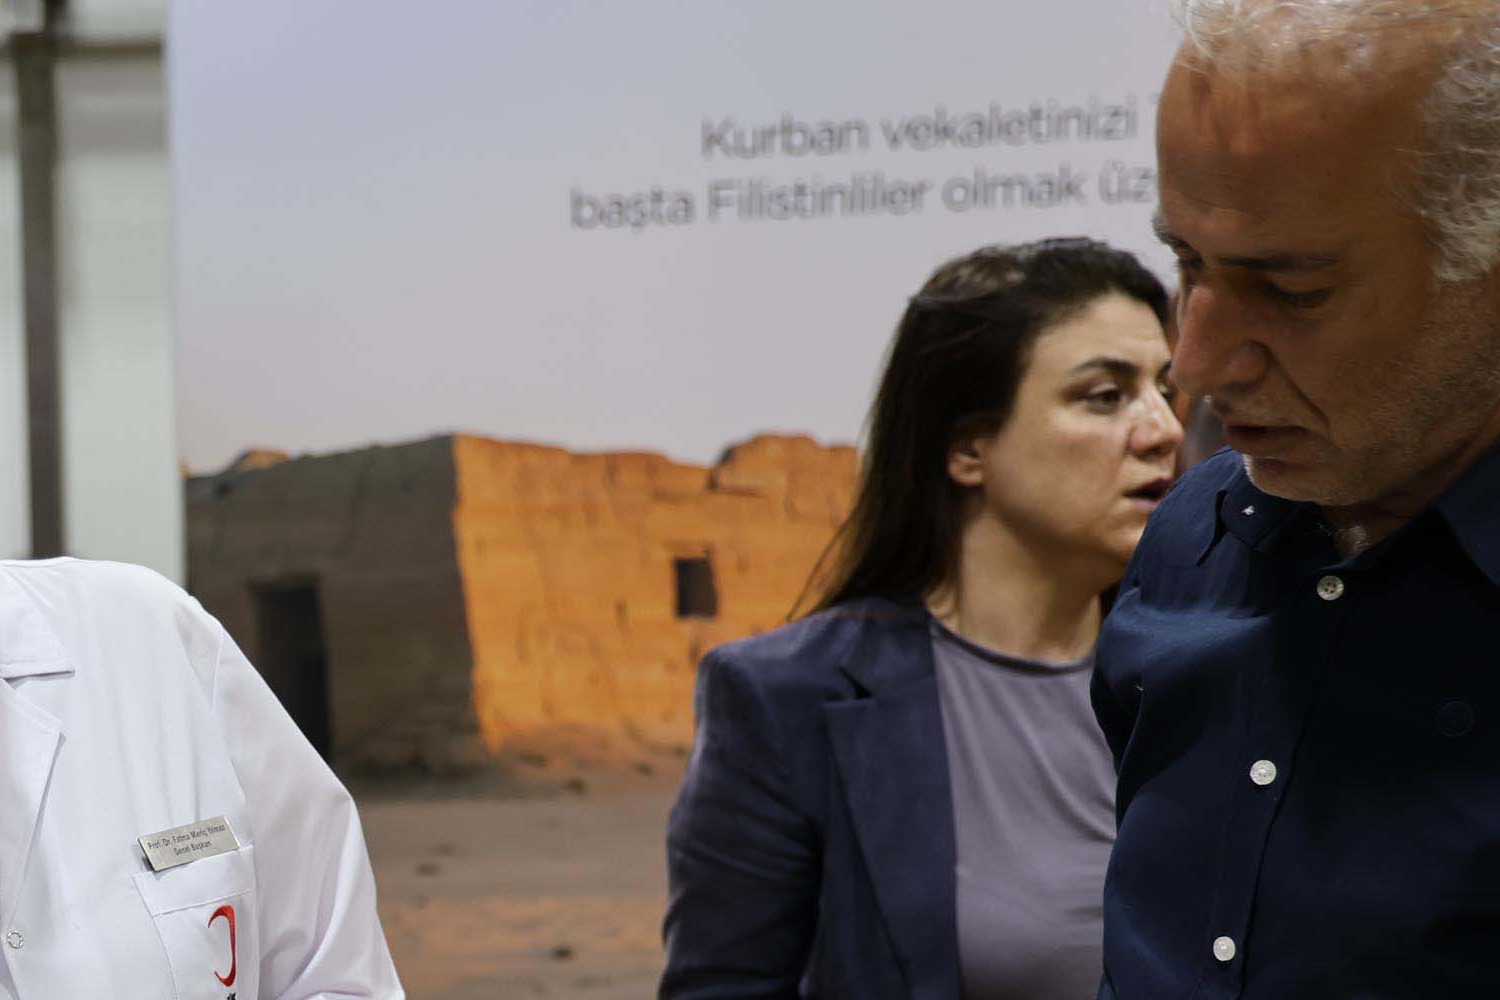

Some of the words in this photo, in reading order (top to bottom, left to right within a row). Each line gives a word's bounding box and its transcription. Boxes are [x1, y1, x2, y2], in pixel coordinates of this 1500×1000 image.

[701, 116, 869, 161] Kurban
[881, 94, 1139, 151] vekaletinizi
[570, 187, 697, 233] başta
[708, 169, 933, 222] Filistinliler
[942, 162, 1087, 214] olmak
[1099, 160, 1158, 204] üz
